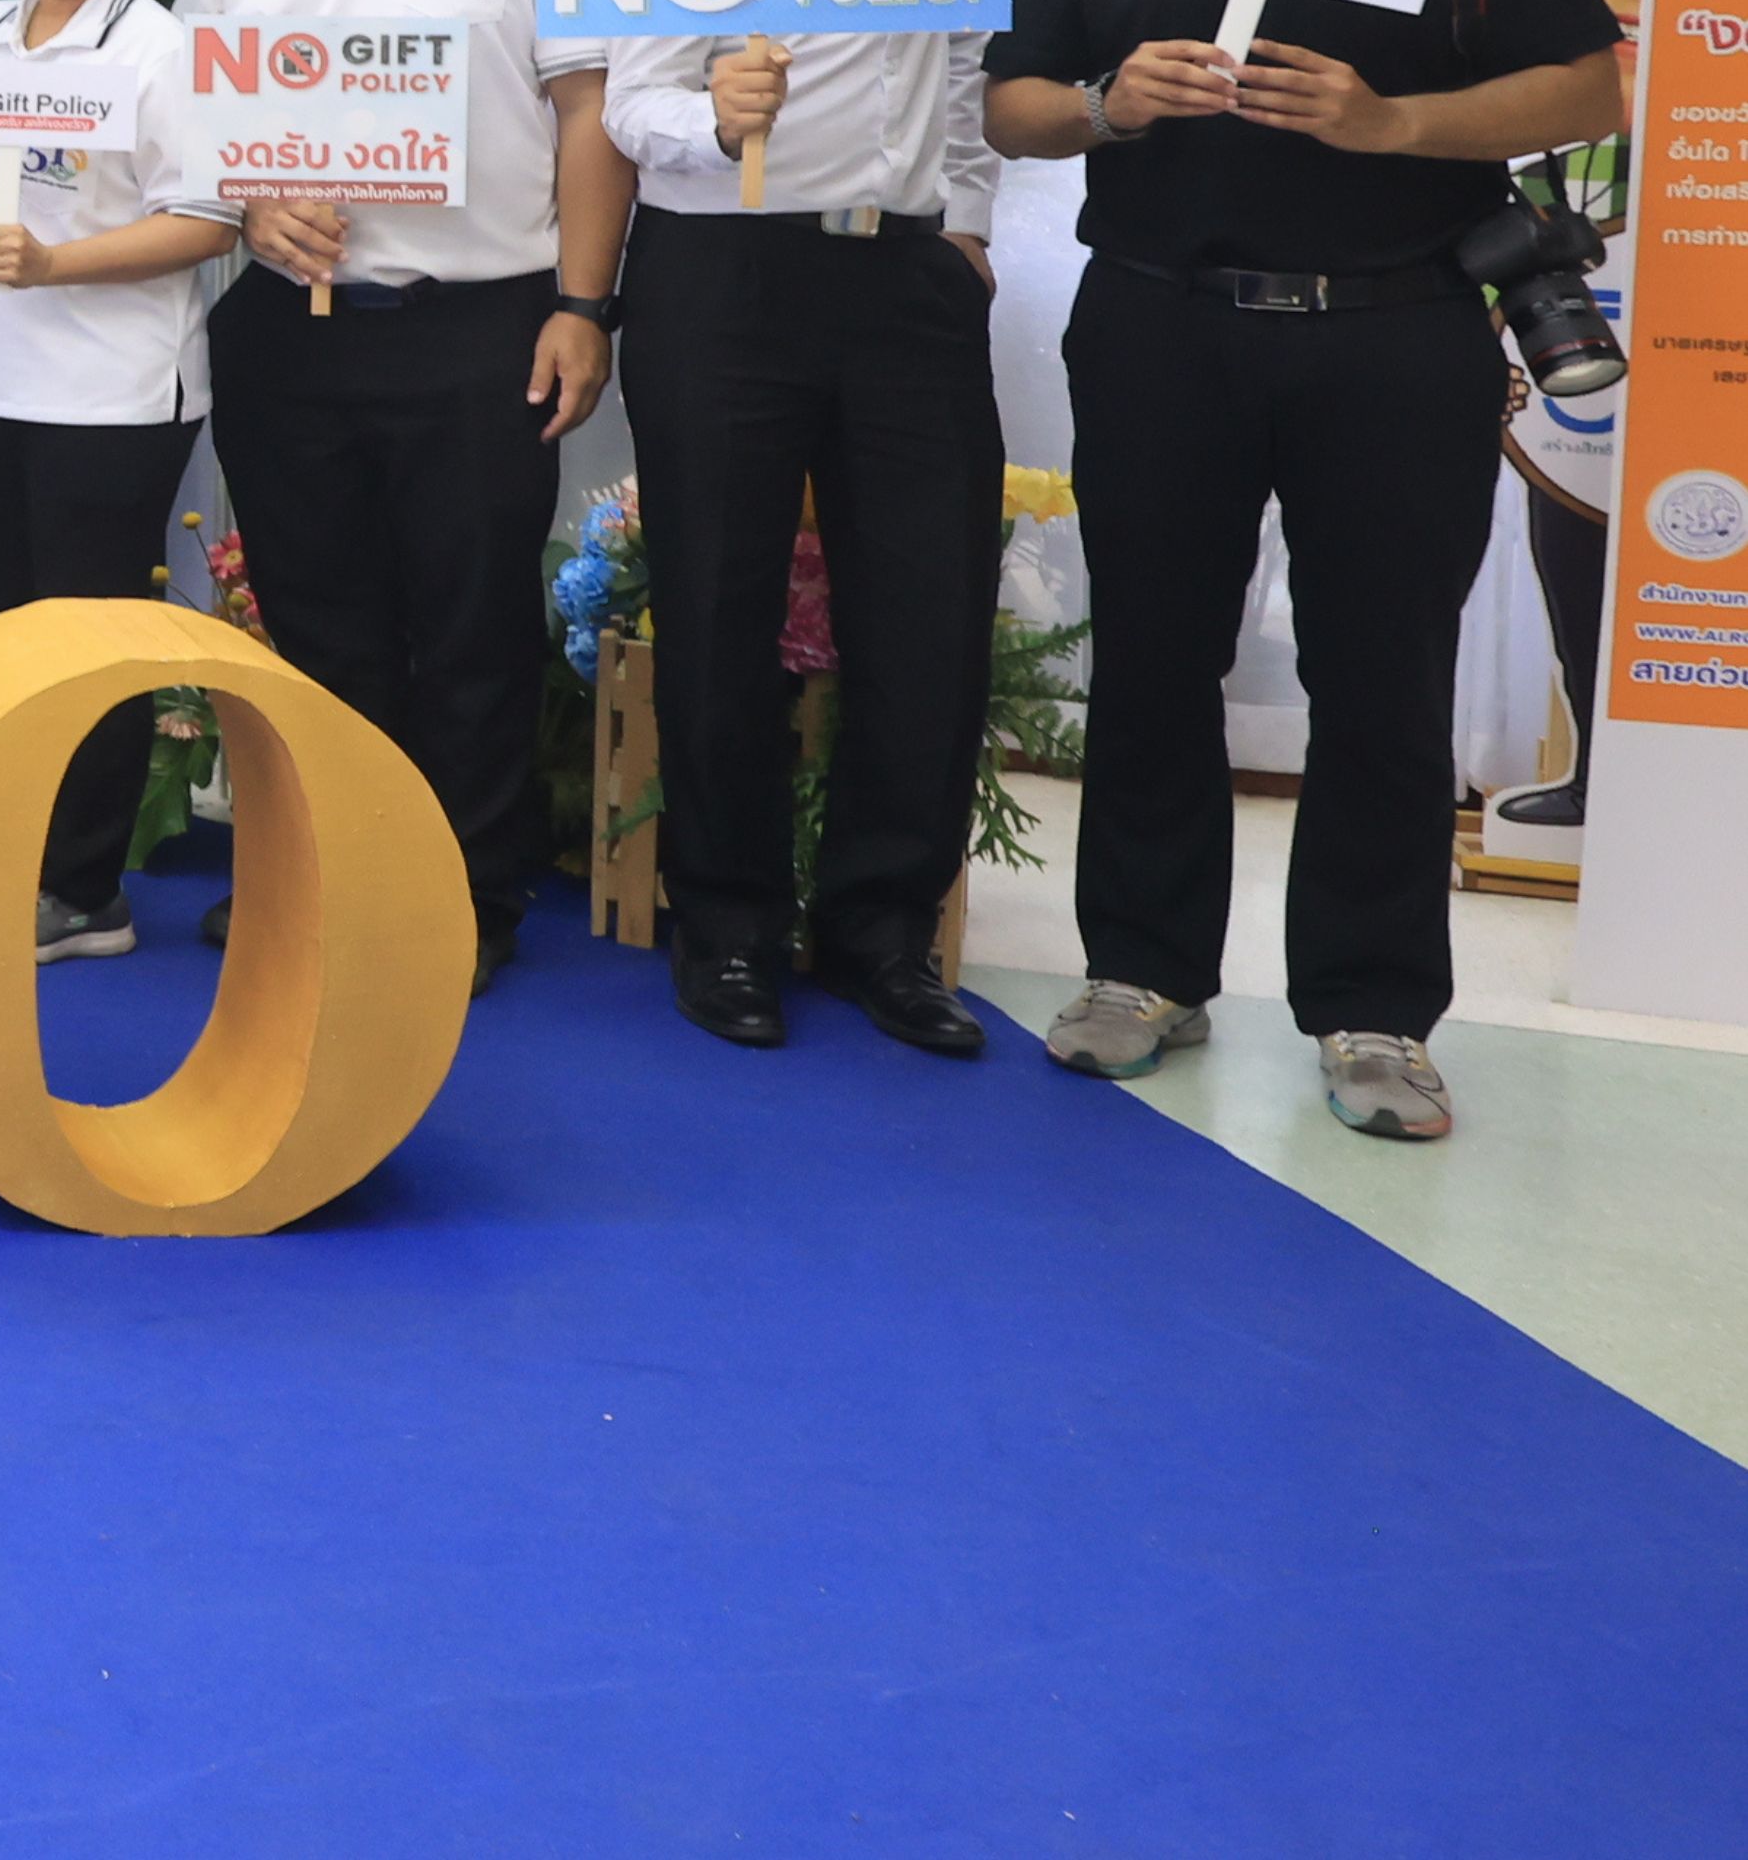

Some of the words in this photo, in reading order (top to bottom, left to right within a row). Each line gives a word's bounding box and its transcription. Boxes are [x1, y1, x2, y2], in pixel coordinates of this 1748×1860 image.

[193, 27, 329, 94] NO
[342, 34, 452, 67] GIFT
[341, 72, 452, 94] POLICY
[37, 94, 112, 120] Policy
[218, 132, 330, 169] งดรับ
[344, 128, 450, 171] งดให้
[223, 182, 279, 200] ของขวัญ
[1641, 584, 1748, 606] สำนักงานก
